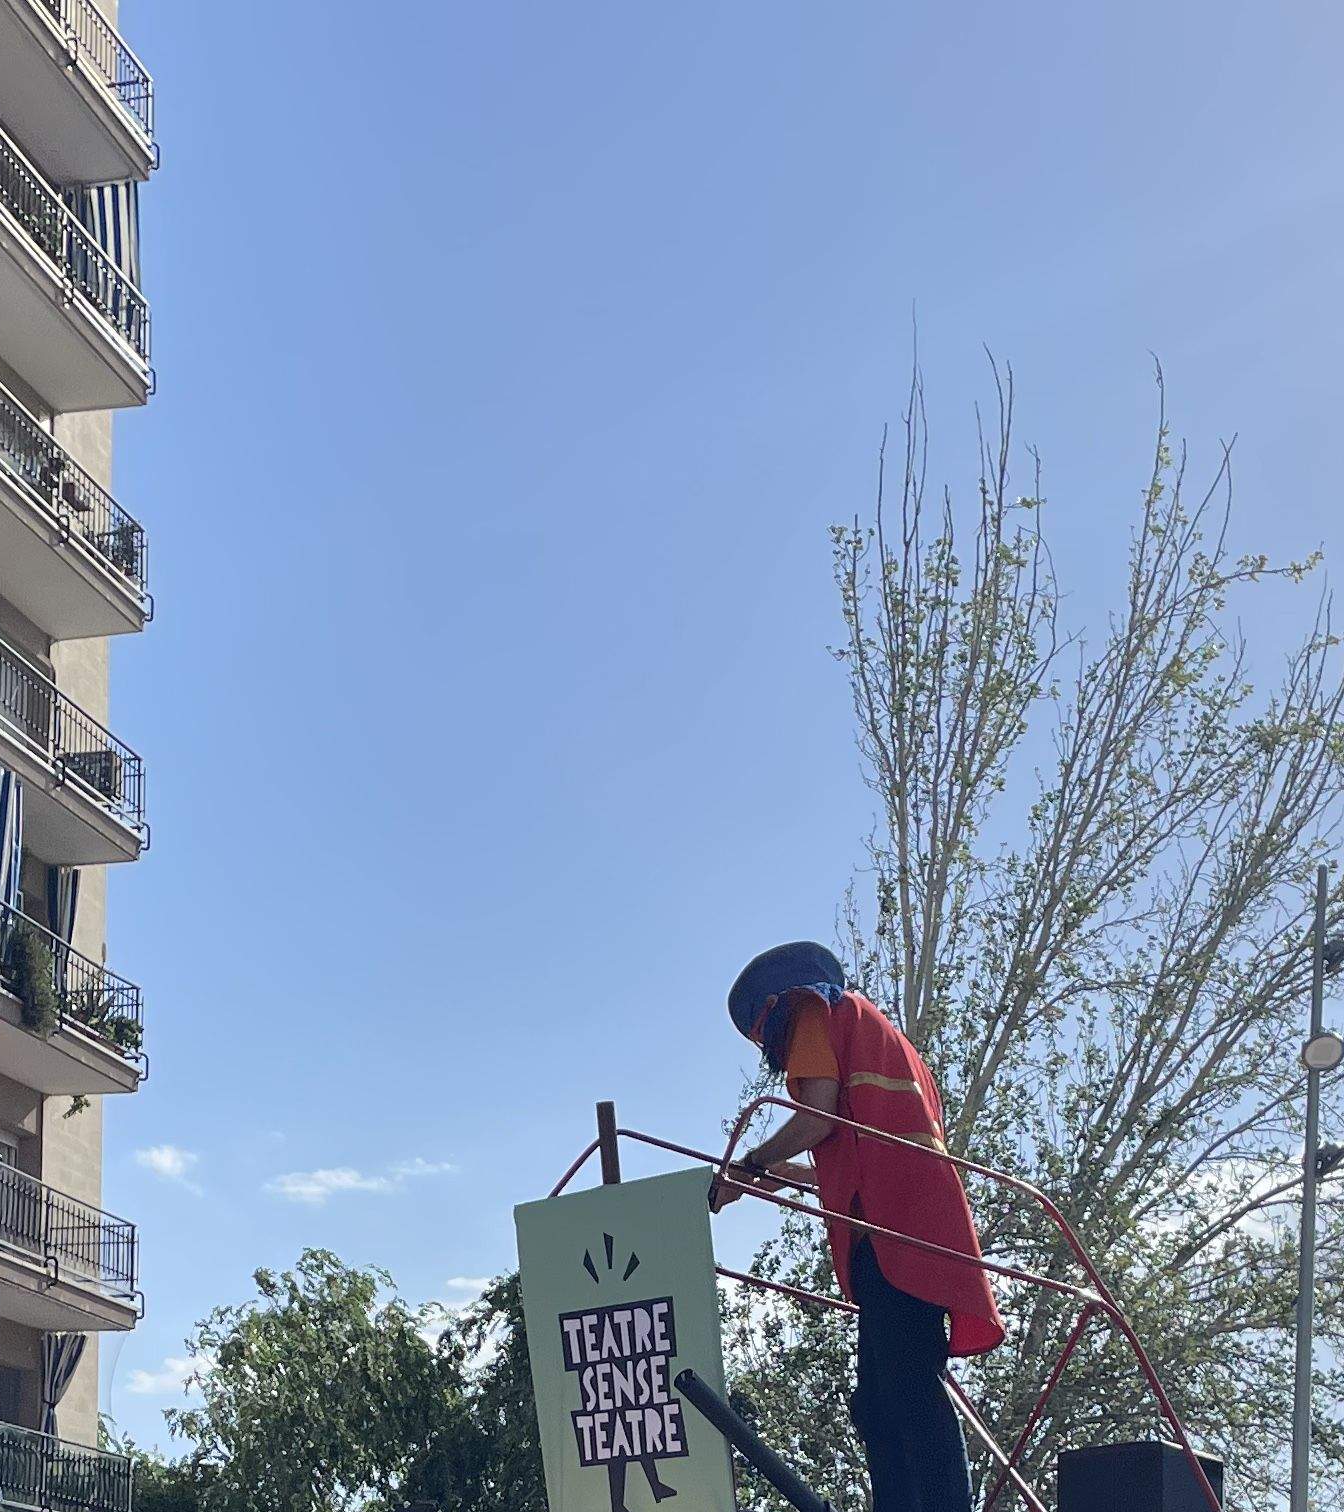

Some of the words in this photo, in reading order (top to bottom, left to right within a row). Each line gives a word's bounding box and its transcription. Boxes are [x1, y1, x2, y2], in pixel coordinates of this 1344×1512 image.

[563, 1302, 670, 1364] TEATRE
[583, 1355, 668, 1411] SENSE
[577, 1404, 681, 1460] TEATRE
